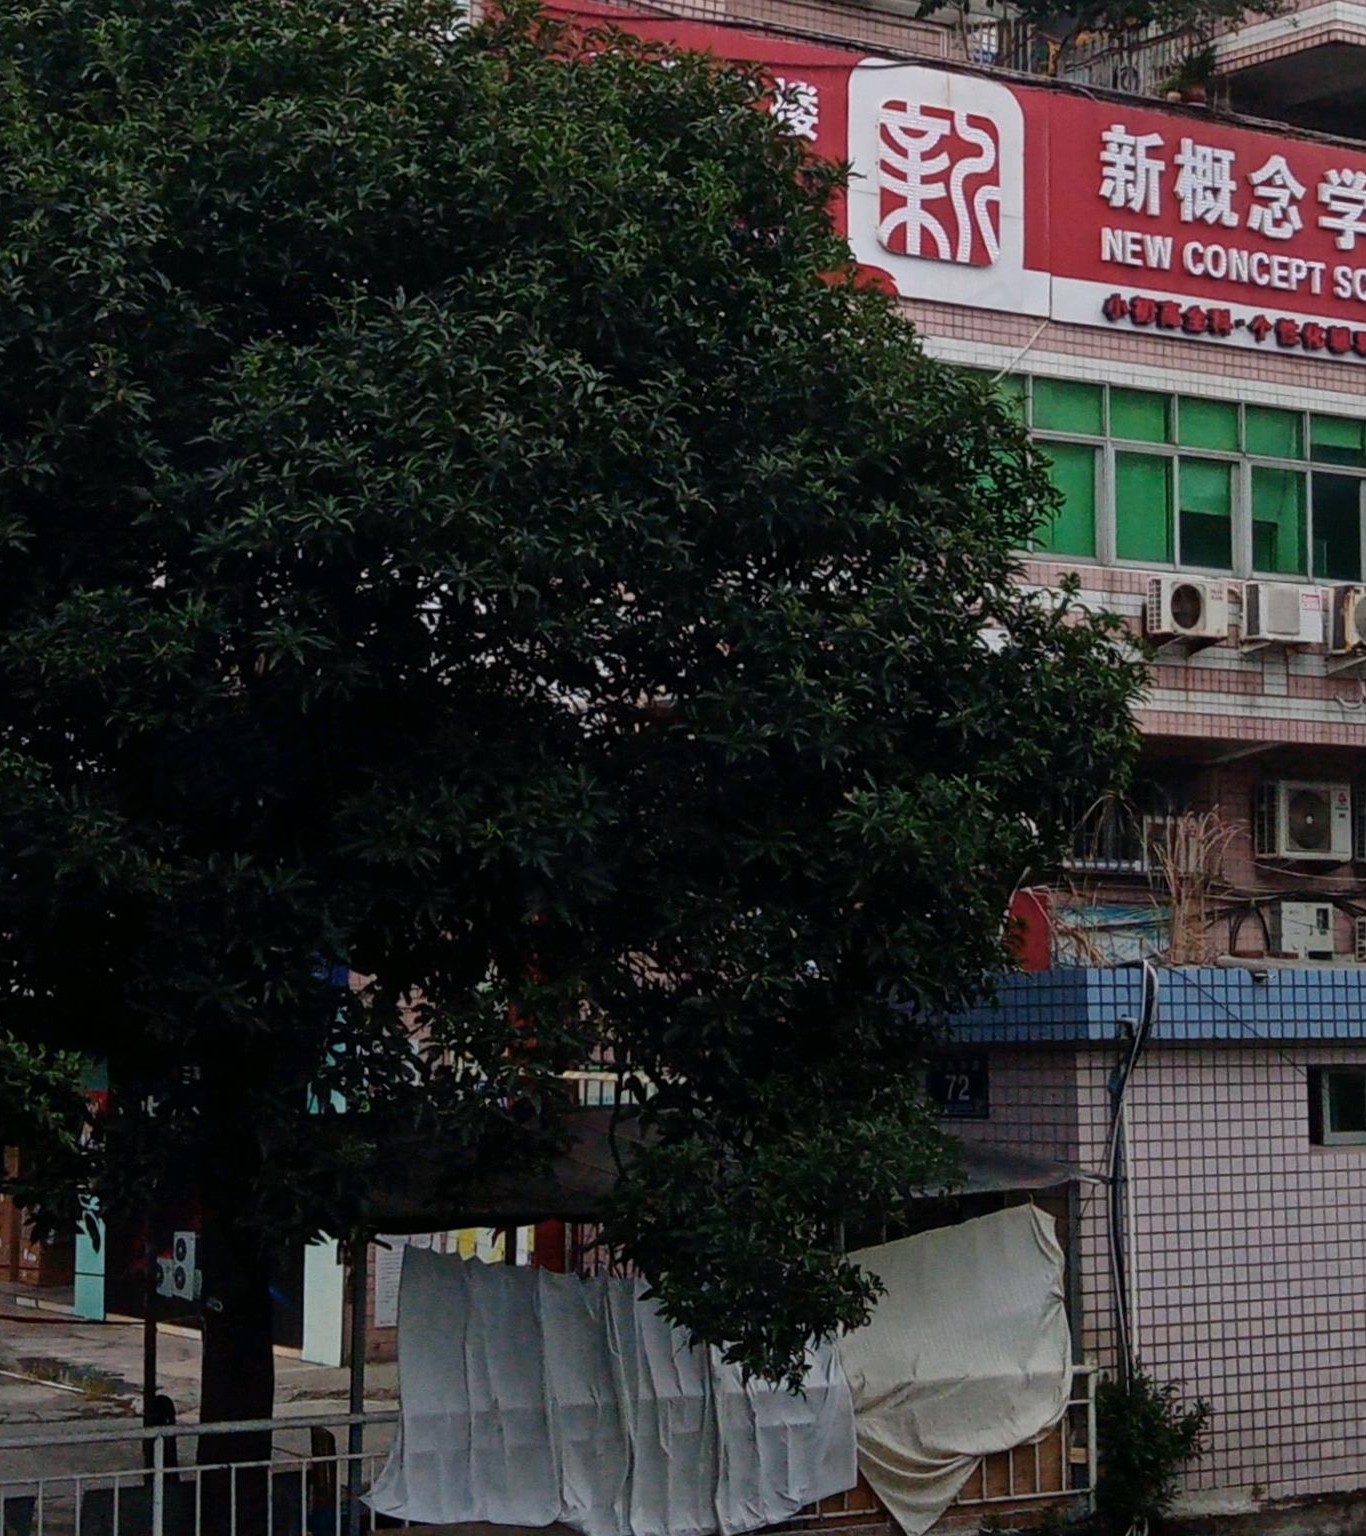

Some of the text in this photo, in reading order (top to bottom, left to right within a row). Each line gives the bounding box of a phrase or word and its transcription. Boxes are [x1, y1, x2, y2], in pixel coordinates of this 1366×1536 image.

[1101, 227, 1173, 270] NEW
[1182, 241, 1325, 295] CONCEPT
[944, 1074, 970, 1101] 72
